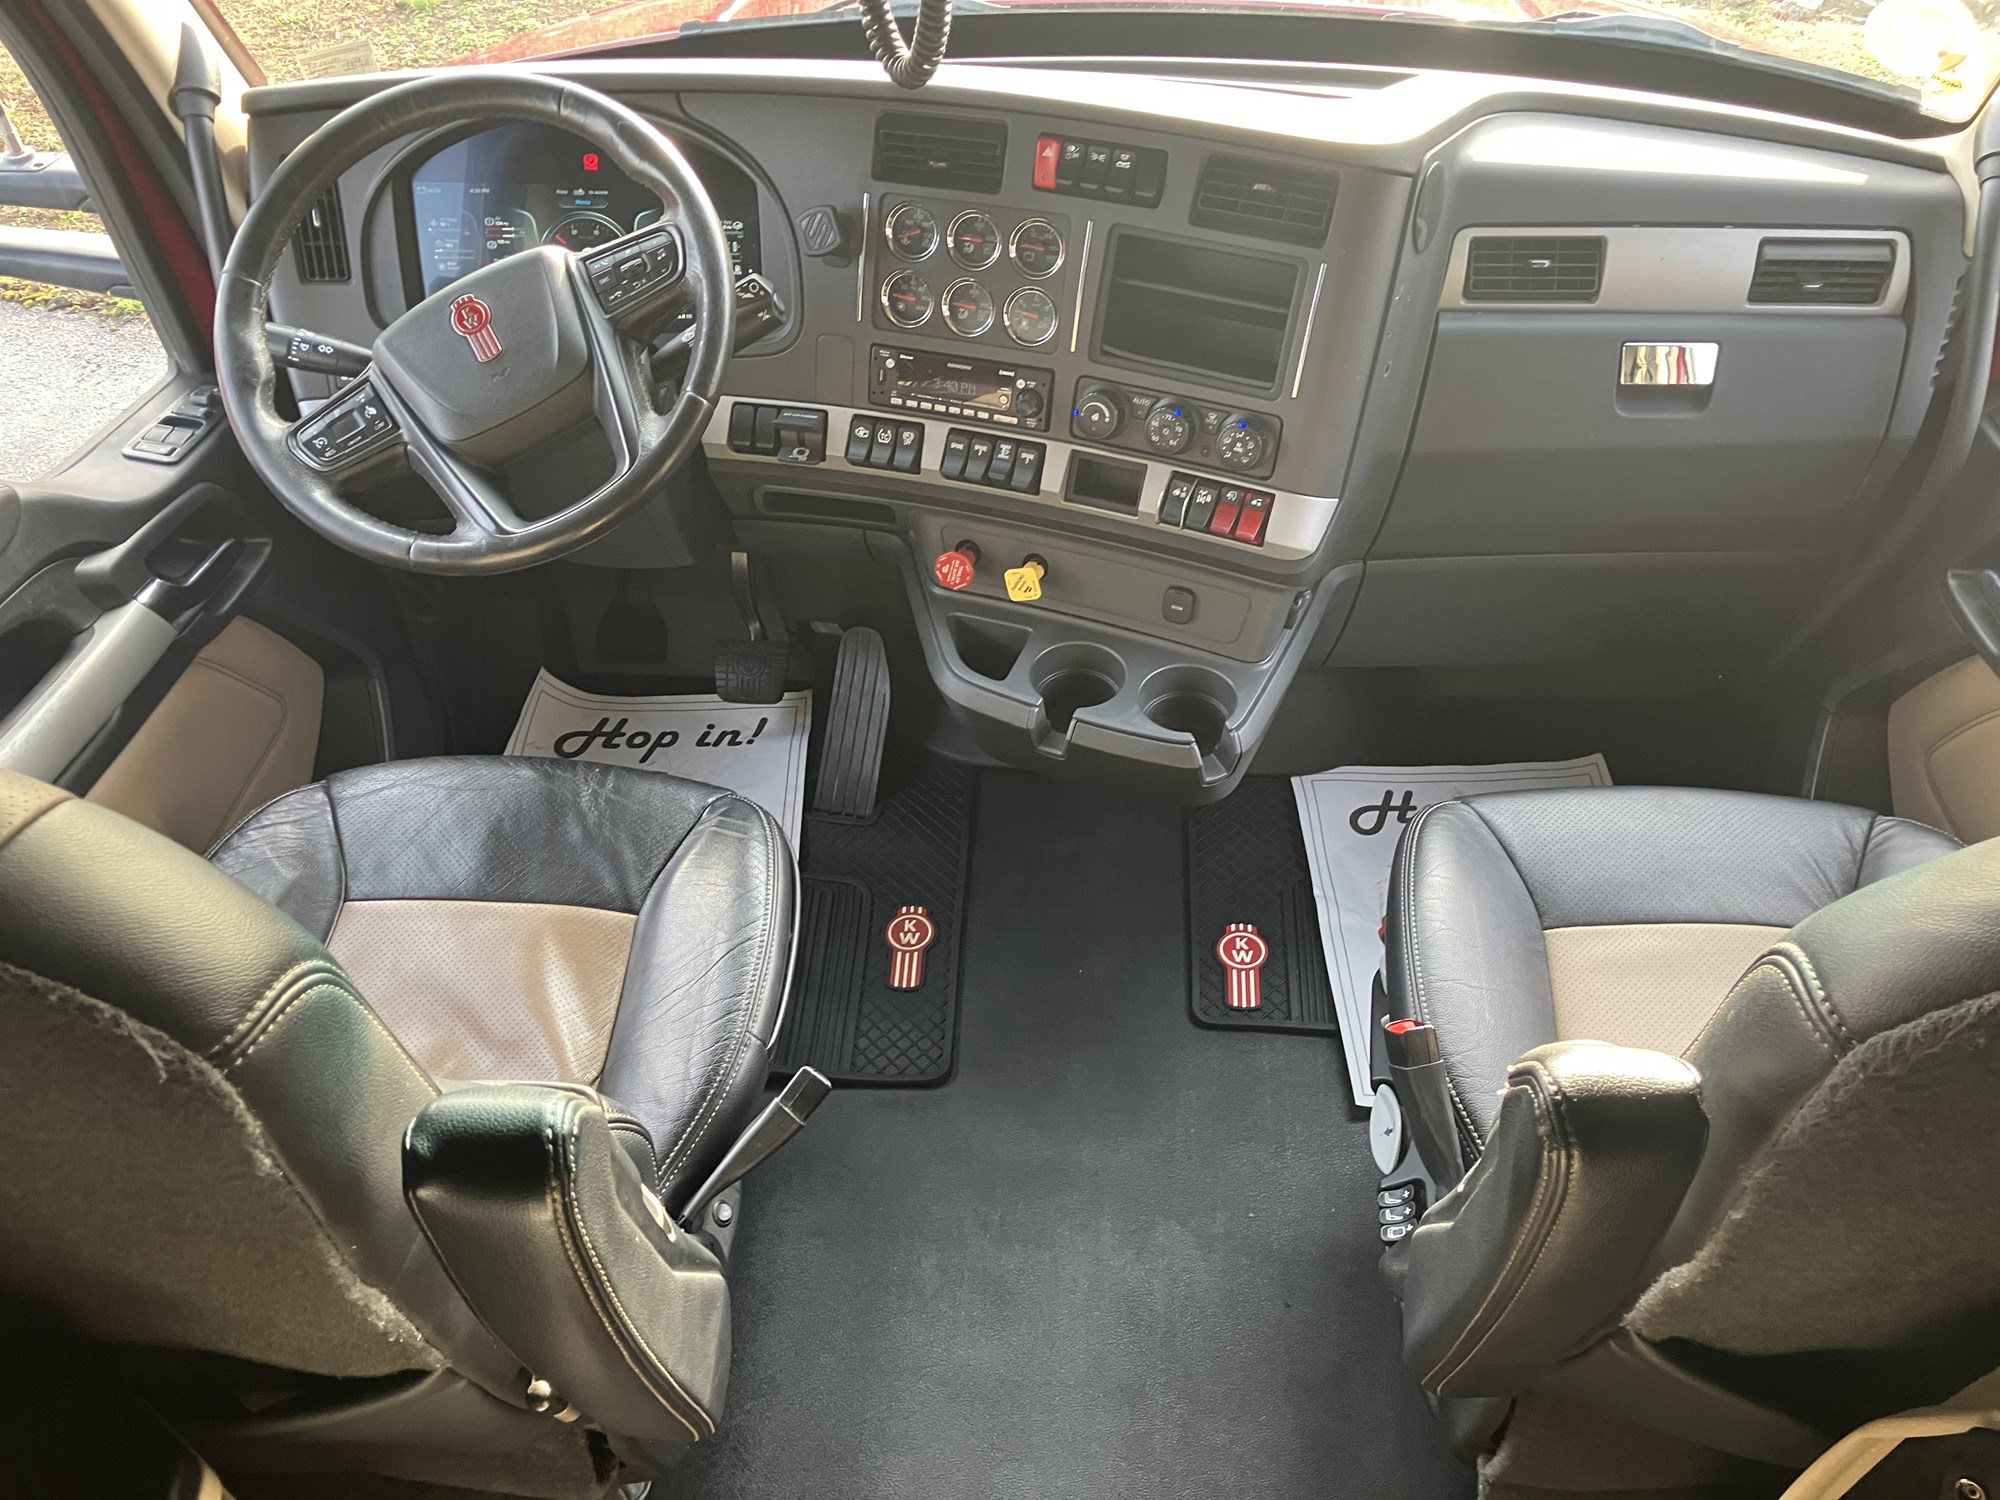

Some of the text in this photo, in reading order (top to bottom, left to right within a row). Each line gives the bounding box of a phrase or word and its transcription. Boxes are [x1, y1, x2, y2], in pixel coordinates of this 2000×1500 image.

[960, 382, 976, 395] PM
[1132, 396, 1150, 407] AUTO
[553, 717, 768, 763] Hop in!
